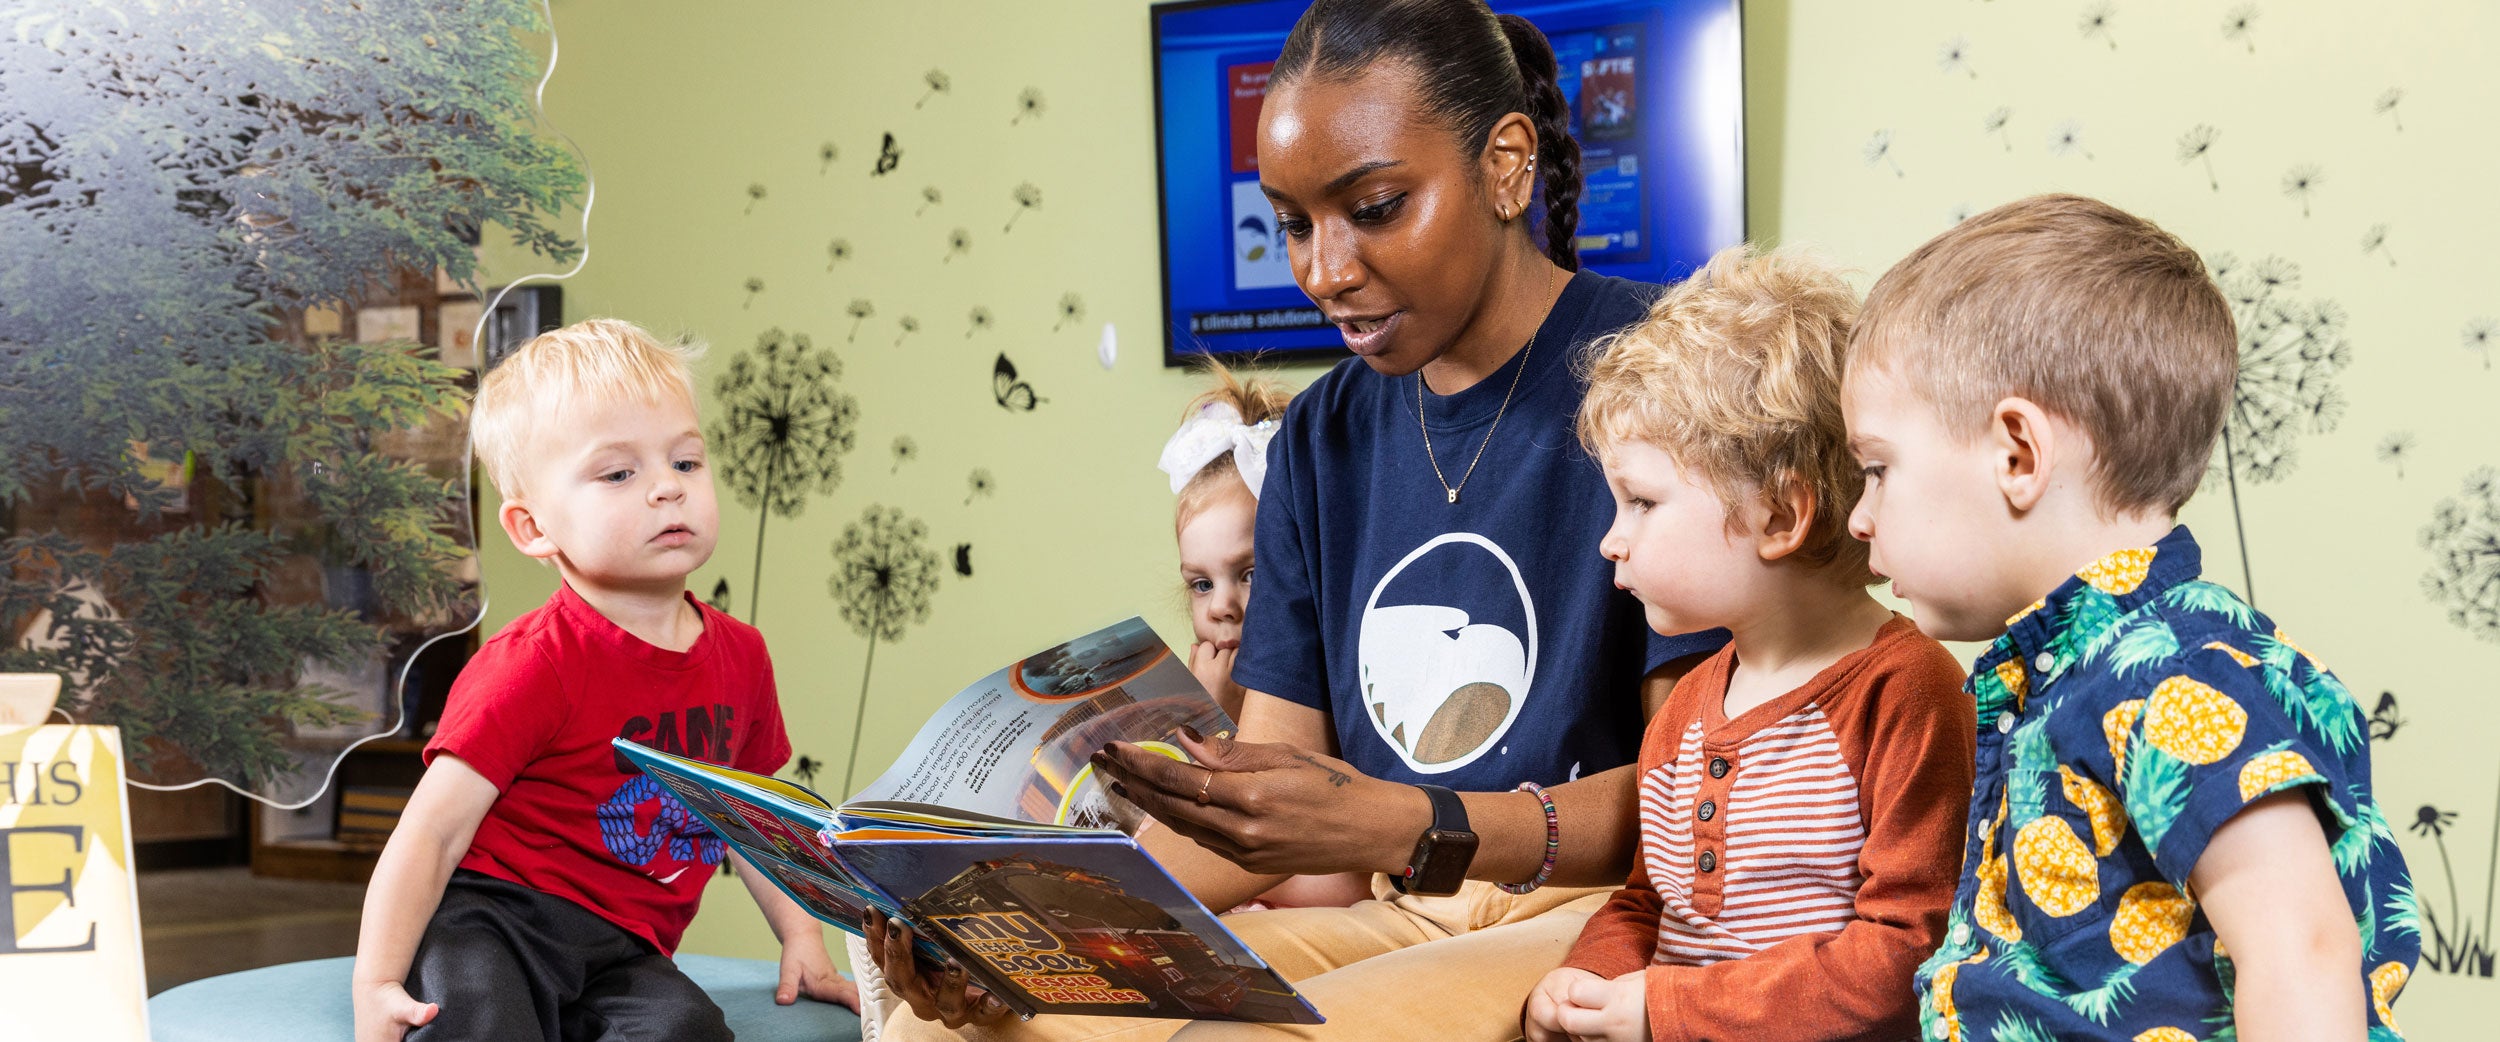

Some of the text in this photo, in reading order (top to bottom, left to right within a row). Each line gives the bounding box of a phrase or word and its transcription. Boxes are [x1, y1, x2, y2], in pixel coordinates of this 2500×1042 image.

[1581, 58, 1634, 78] SFTIE
[1202, 314, 1254, 330] climate
[1256, 310, 1321, 328] solutions
[912, 754, 930, 779] water
[929, 726, 952, 755] pumps
[951, 710, 967, 726] and
[967, 687, 998, 712] nozzles
[915, 771, 932, 793] most
[931, 729, 961, 772] important
[961, 693, 1002, 730] equipment
[940, 748, 959, 774] Some
[958, 732, 972, 748] can
[972, 711, 993, 733] spray
[968, 710, 1029, 777] Seven fireboats shoot
[942, 770, 957, 790] than
[956, 751, 969, 769] 400
[967, 734, 982, 751] feet
[981, 719, 997, 734] into
[969, 765, 987, 789] water
[983, 757, 991, 768] at
[994, 728, 1017, 752] burning
[1016, 719, 1026, 728] oil
[991, 754, 1001, 767] the
[1001, 735, 1017, 754] Mega
[933, 913, 1061, 952] my
[966, 941, 1030, 954] little
[987, 954, 1094, 973] book
[1016, 974, 1109, 989] rescue
[1033, 989, 1147, 1003] vehicles
